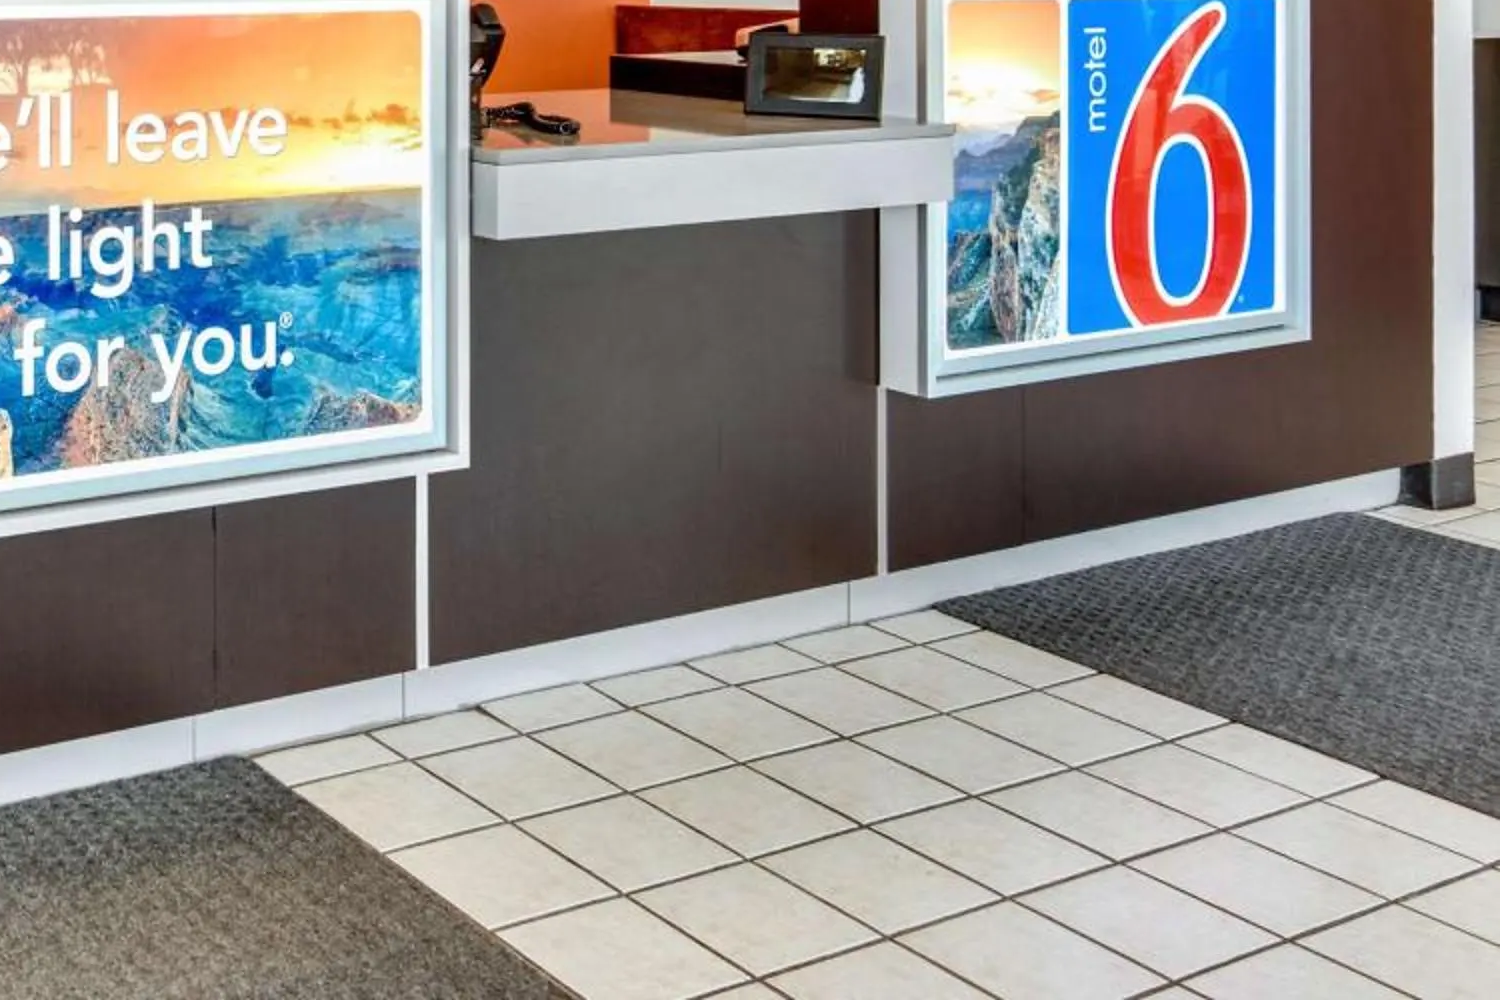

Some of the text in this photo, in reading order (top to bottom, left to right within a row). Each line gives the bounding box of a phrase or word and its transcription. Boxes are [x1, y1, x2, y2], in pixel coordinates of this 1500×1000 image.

[106, 90, 288, 166] leave
[1083, 27, 1107, 132] motel
[1105, 0, 1252, 329] 6
[47, 199, 213, 298] light
[14, 319, 127, 397] for
